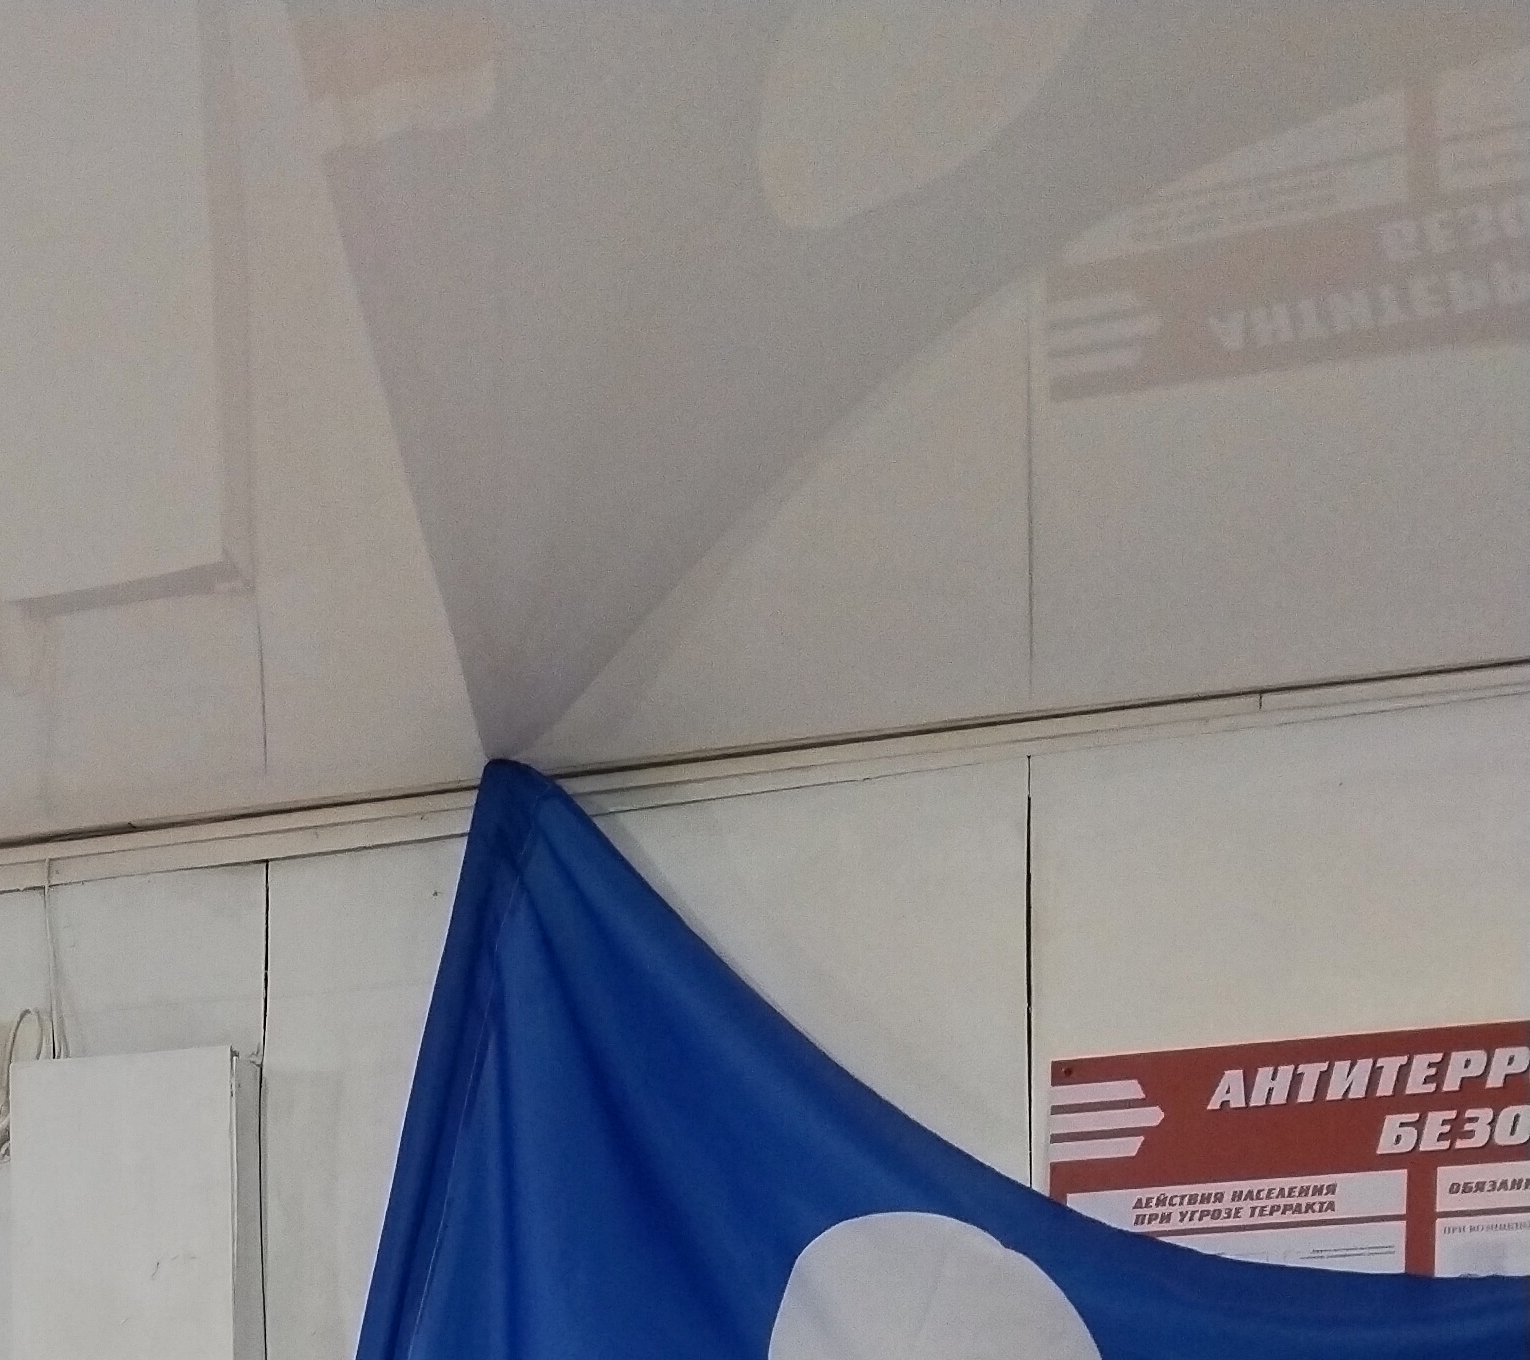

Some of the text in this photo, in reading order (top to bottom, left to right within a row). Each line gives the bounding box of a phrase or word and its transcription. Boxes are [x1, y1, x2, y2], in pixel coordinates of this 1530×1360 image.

[1206, 1046, 1530, 1111] АНТИТЕРР
[1376, 1105, 1530, 1155] БЕЗО
[1132, 1182, 1338, 1210] ДЕЙСТВИЯ НАСЕЛЕНИЯ
[1133, 1200, 1336, 1226] ПРИ УГРОЗЕ ТЕРРАКТА
